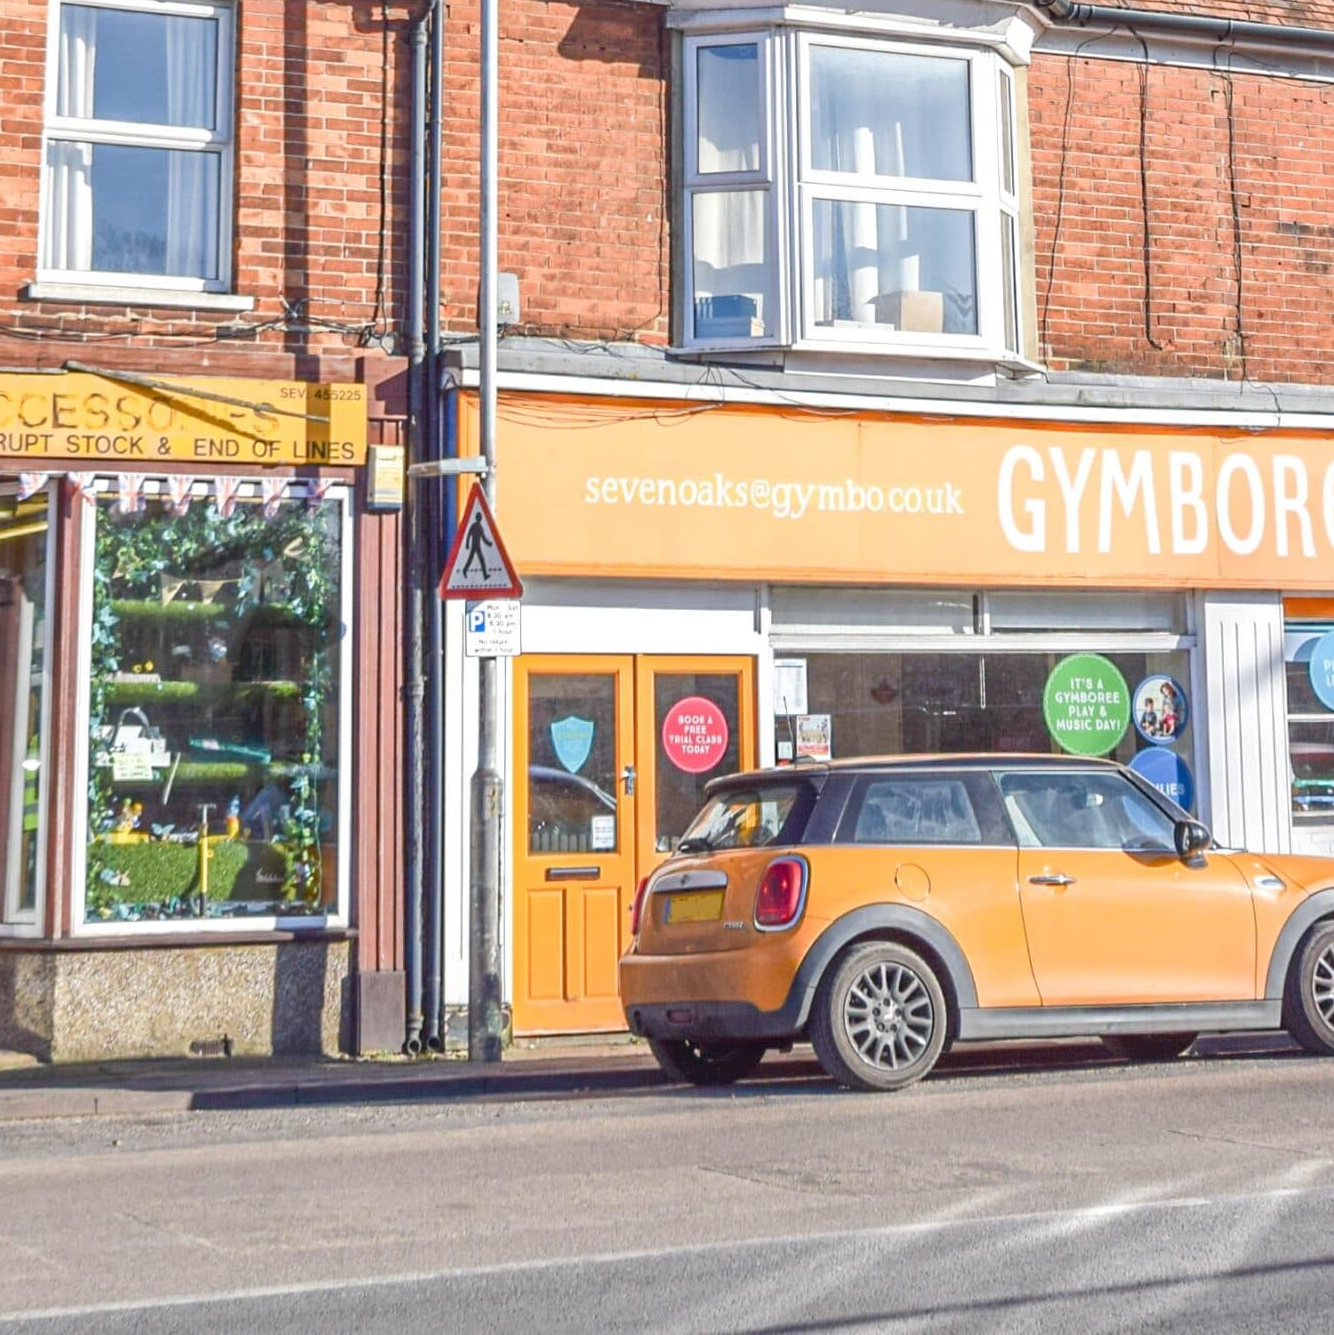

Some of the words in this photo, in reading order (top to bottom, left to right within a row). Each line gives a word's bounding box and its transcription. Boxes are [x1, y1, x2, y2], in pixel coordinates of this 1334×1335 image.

[313, 389, 362, 402] 455225
[66, 434, 144, 455] STOCK
[157, 436, 171, 455] &
[194, 438, 240, 458] END
[252, 440, 282, 458] OF
[293, 441, 355, 460] LINES
[585, 473, 965, 519] sevenoaks@gymbo.co.uk
[1070, 678, 1093, 691] IT'S
[1097, 678, 1104, 690] A
[1054, 692, 1120, 704] GYMBOREE
[1068, 705, 1095, 717] PLAY
[1099, 706, 1108, 717] &
[678, 715, 704, 725] BOOK
[707, 715, 714, 725] A
[1095, 719, 1121, 731] DAY!
[683, 725, 707, 735] FREE
[669, 735, 692, 744] TRIAL
[695, 735, 722, 744] CLASS
[682, 745, 710, 754] TODAY
